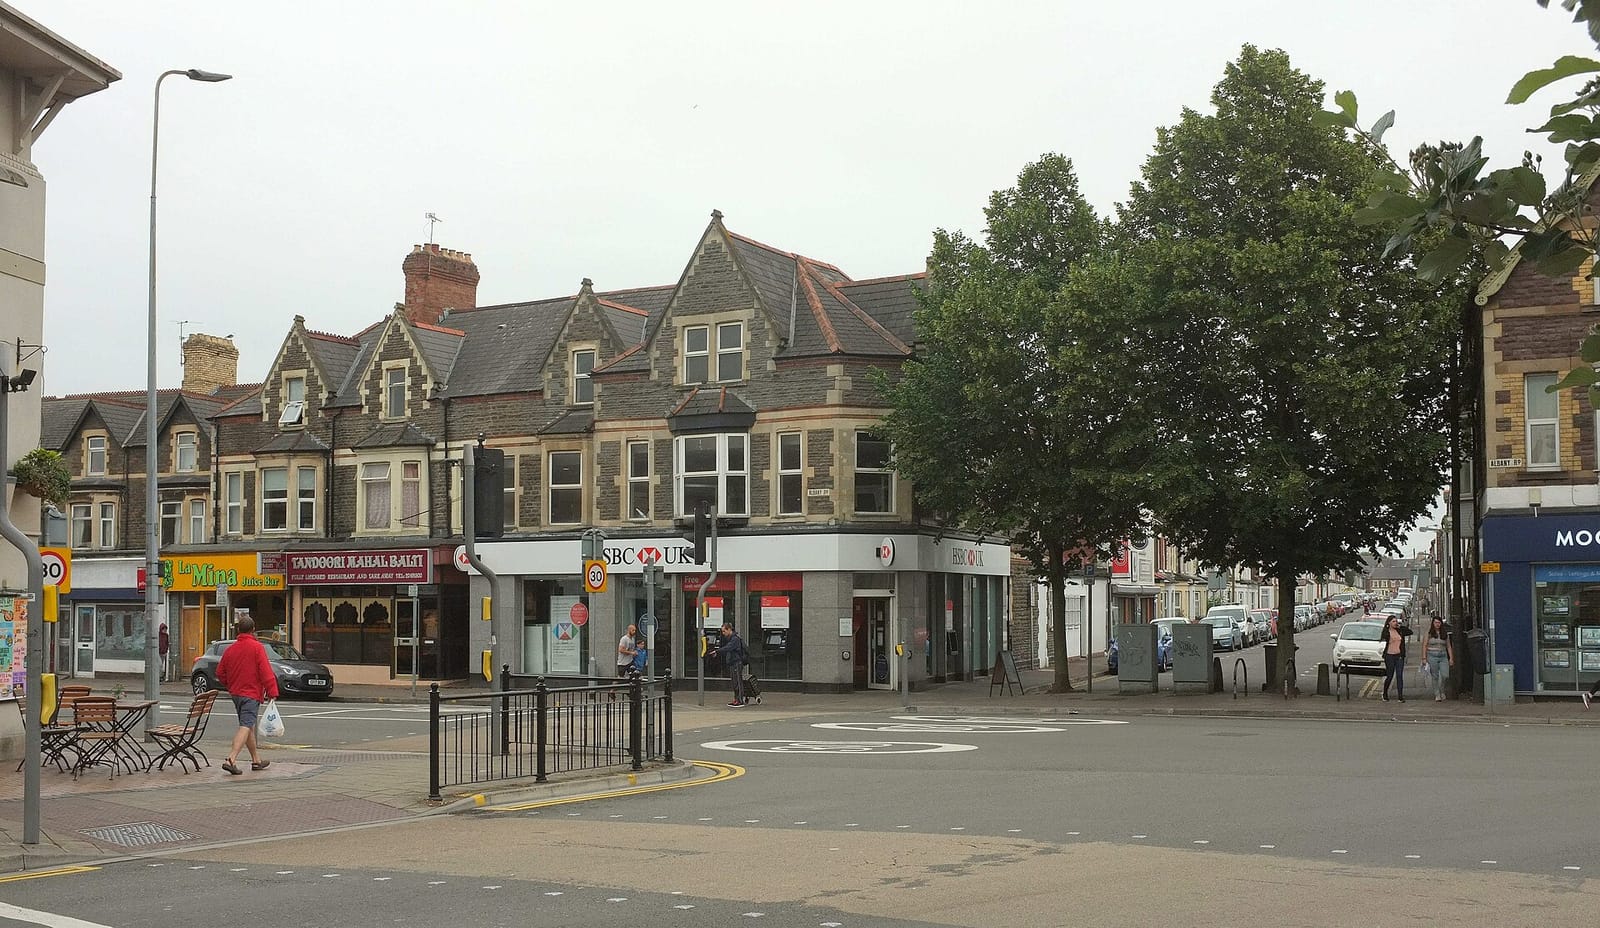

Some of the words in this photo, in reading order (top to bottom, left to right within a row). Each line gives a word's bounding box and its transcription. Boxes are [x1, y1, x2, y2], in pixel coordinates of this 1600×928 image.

[292, 556, 345, 570] TANDOORI
[347, 555, 388, 568] MAHAL
[389, 554, 424, 568] BALTI
[663, 547, 693, 564] UK
[952, 547, 967, 566] HSBC
[975, 550, 984, 567] UK
[179, 560, 191, 574] La
[192, 564, 238, 586] Mina
[242, 576, 263, 587] Juice
[264, 575, 279, 587] Bar
[590, 571, 602, 582] 30
[684, 576, 699, 584] Free
